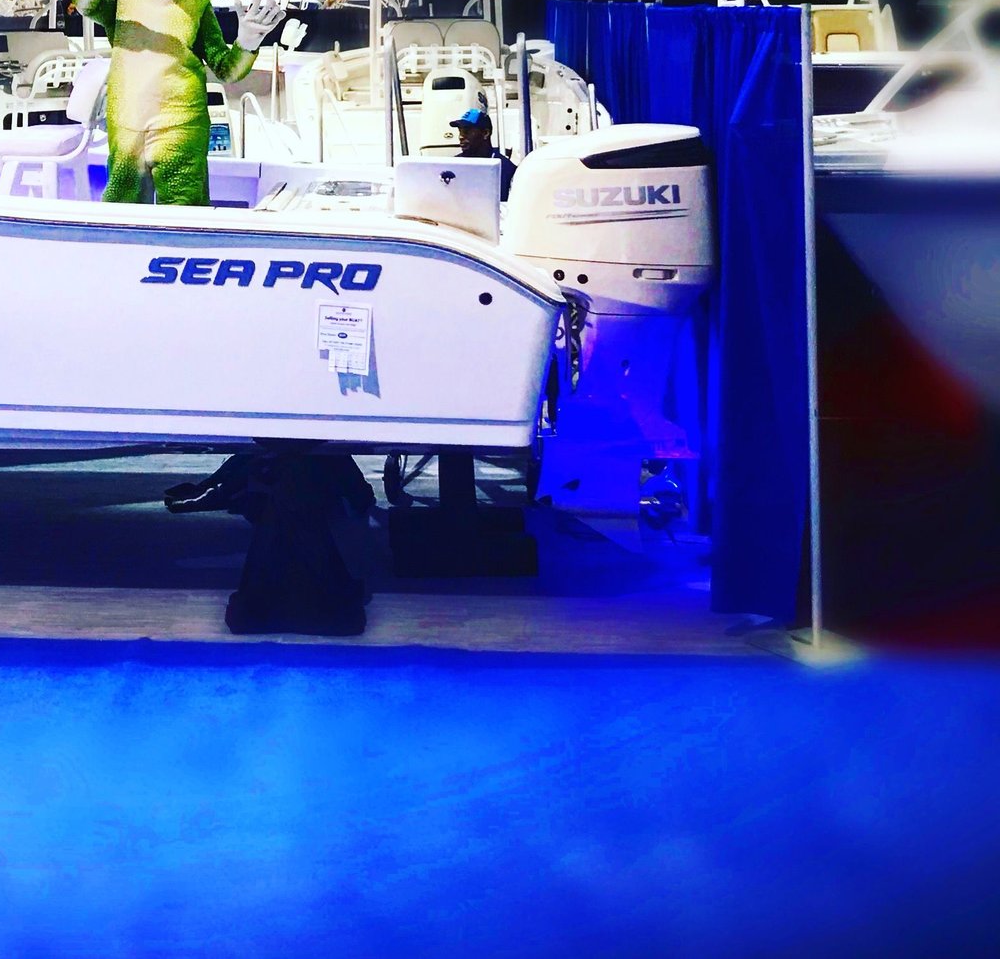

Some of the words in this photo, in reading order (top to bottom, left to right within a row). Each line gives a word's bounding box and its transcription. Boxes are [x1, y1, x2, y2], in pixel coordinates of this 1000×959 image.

[553, 184, 681, 208] SUZUKI
[140, 256, 256, 287] SEA
[262, 260, 383, 296] PRO
